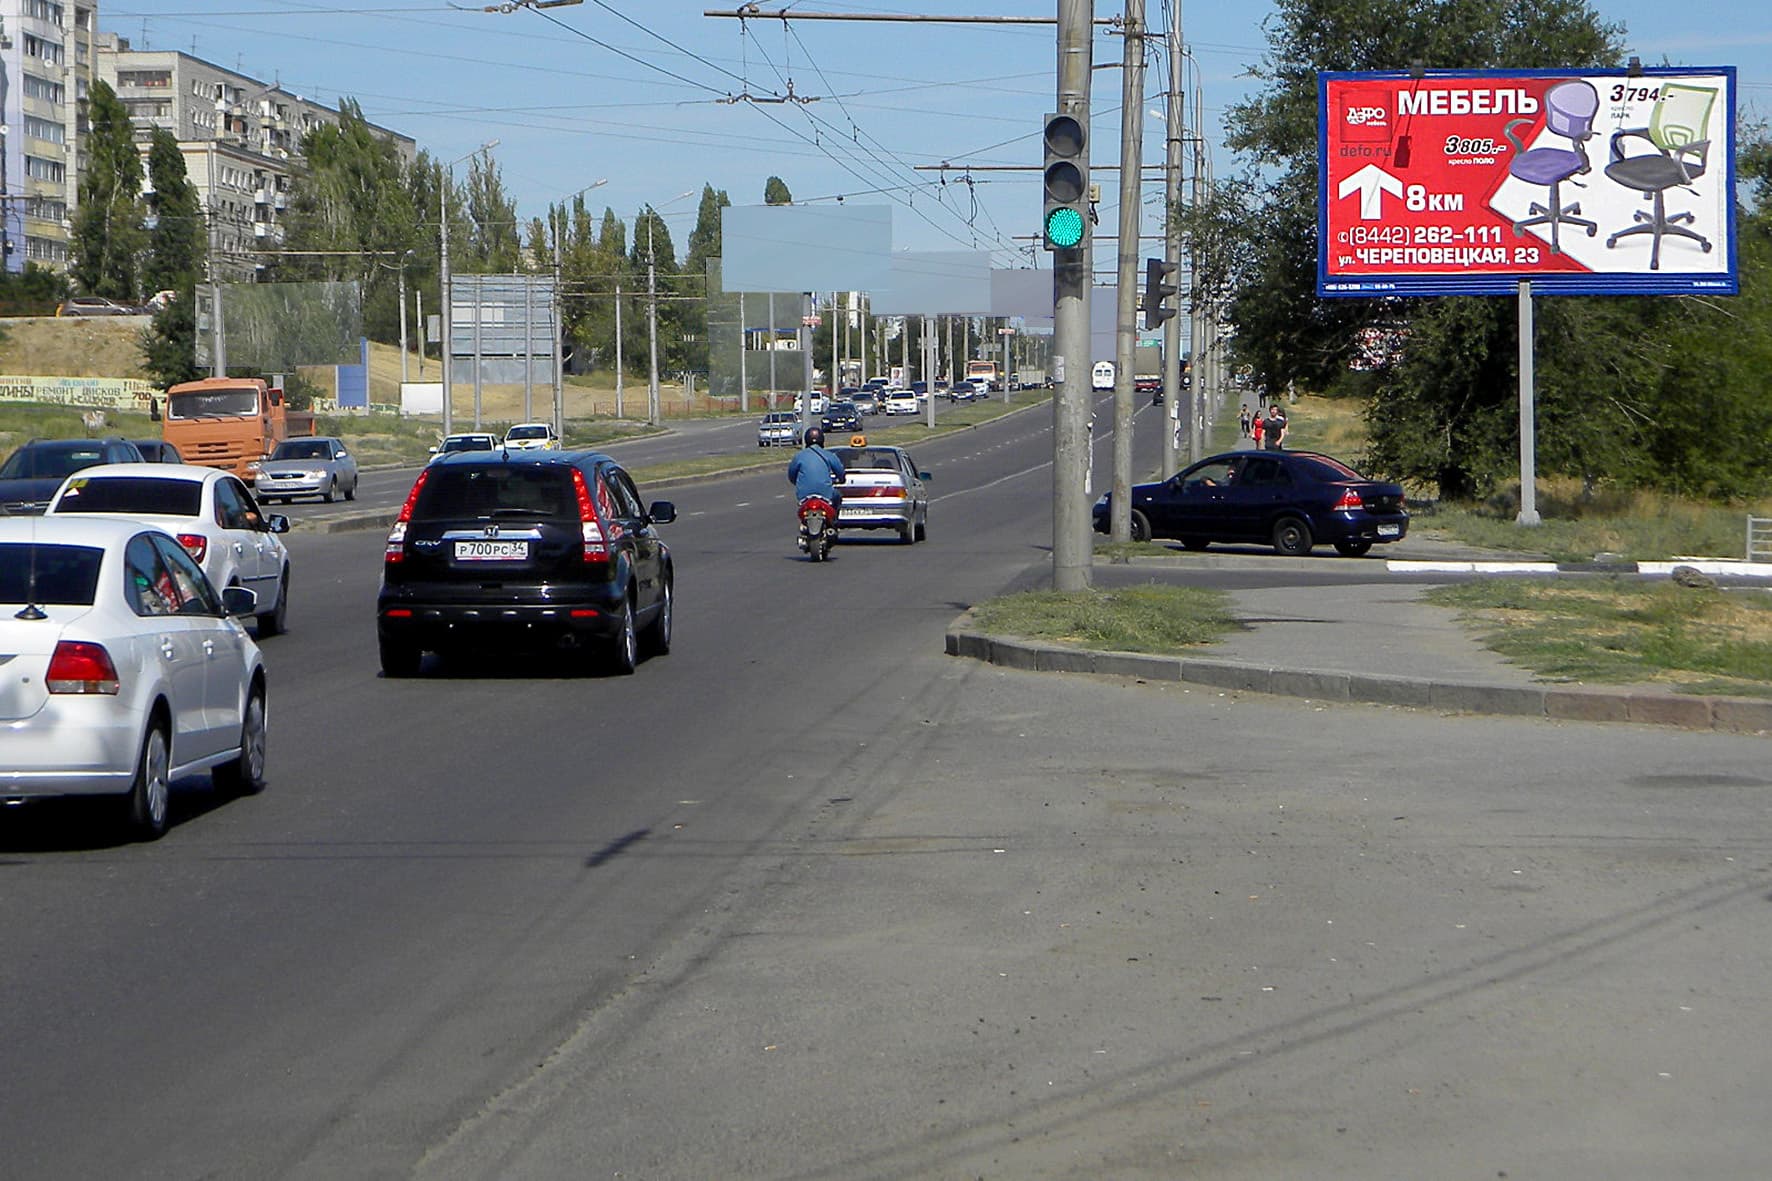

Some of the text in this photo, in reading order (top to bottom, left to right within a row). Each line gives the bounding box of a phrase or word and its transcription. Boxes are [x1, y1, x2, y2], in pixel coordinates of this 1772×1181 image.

[1398, 88, 1538, 115] МЕБЕЛЬ
[1340, 144, 1392, 157] defo.ru
[1349, 226, 1501, 246] (8442) 262-111
[1338, 247, 1539, 267] ул. ЧЕРЕПОВЕЦКАЯ, 23
